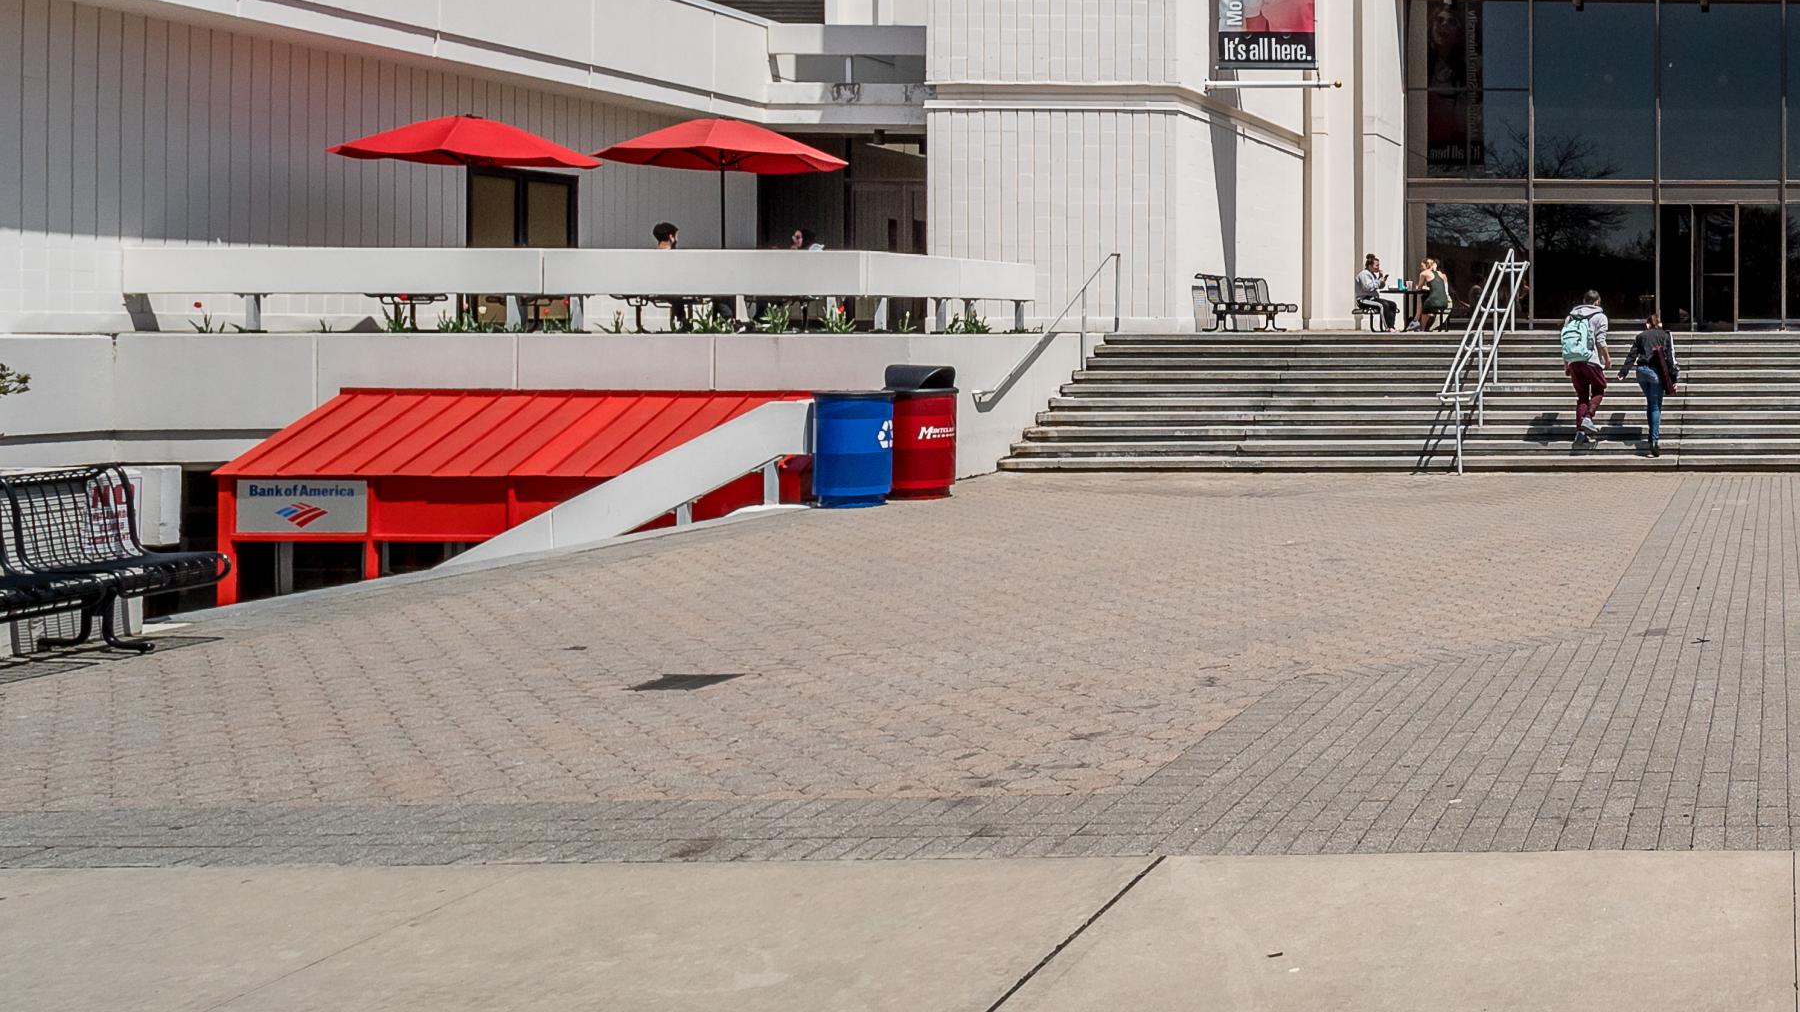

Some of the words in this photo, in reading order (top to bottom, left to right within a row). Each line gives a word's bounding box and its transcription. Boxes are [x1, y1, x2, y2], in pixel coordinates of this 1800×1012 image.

[1223, 37, 1246, 61] It's
[1249, 37, 1269, 61] all
[1271, 37, 1312, 61] here.
[249, 484, 282, 497] Bank
[284, 484, 298, 497] of
[299, 484, 355, 497] America
